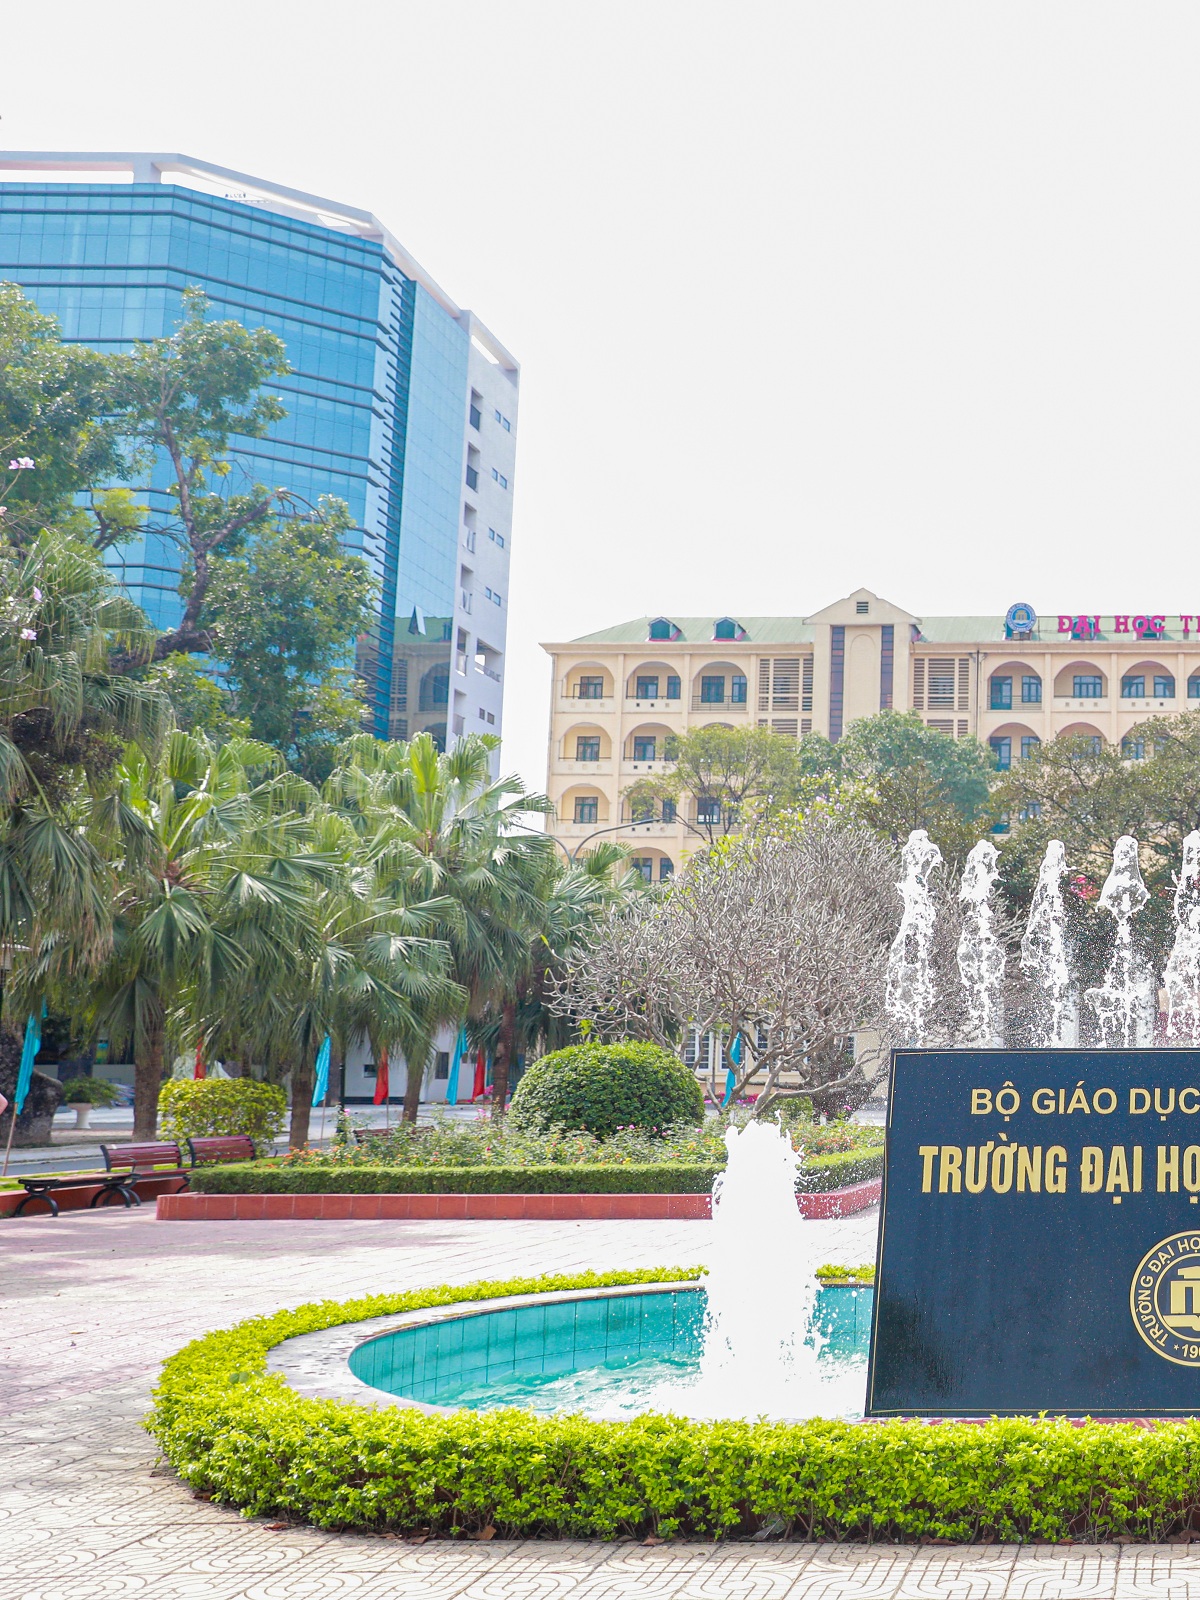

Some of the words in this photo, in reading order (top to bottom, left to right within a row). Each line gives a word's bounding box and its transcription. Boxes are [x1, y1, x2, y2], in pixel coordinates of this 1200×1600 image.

[1057, 615, 1101, 638] ĐẠI
[1114, 615, 1166, 638] HỌC
[970, 1081, 1021, 1121] BỘ
[1031, 1081, 1118, 1114] GIÁO
[1129, 1088, 1200, 1121] DỤC
[918, 1133, 1068, 1193] TRƯỜNG
[1079, 1145, 1143, 1204] ĐẠI
[1147, 1245, 1175, 1273] ĐẠI
[1136, 1275, 1169, 1347] TRƯỜNG
